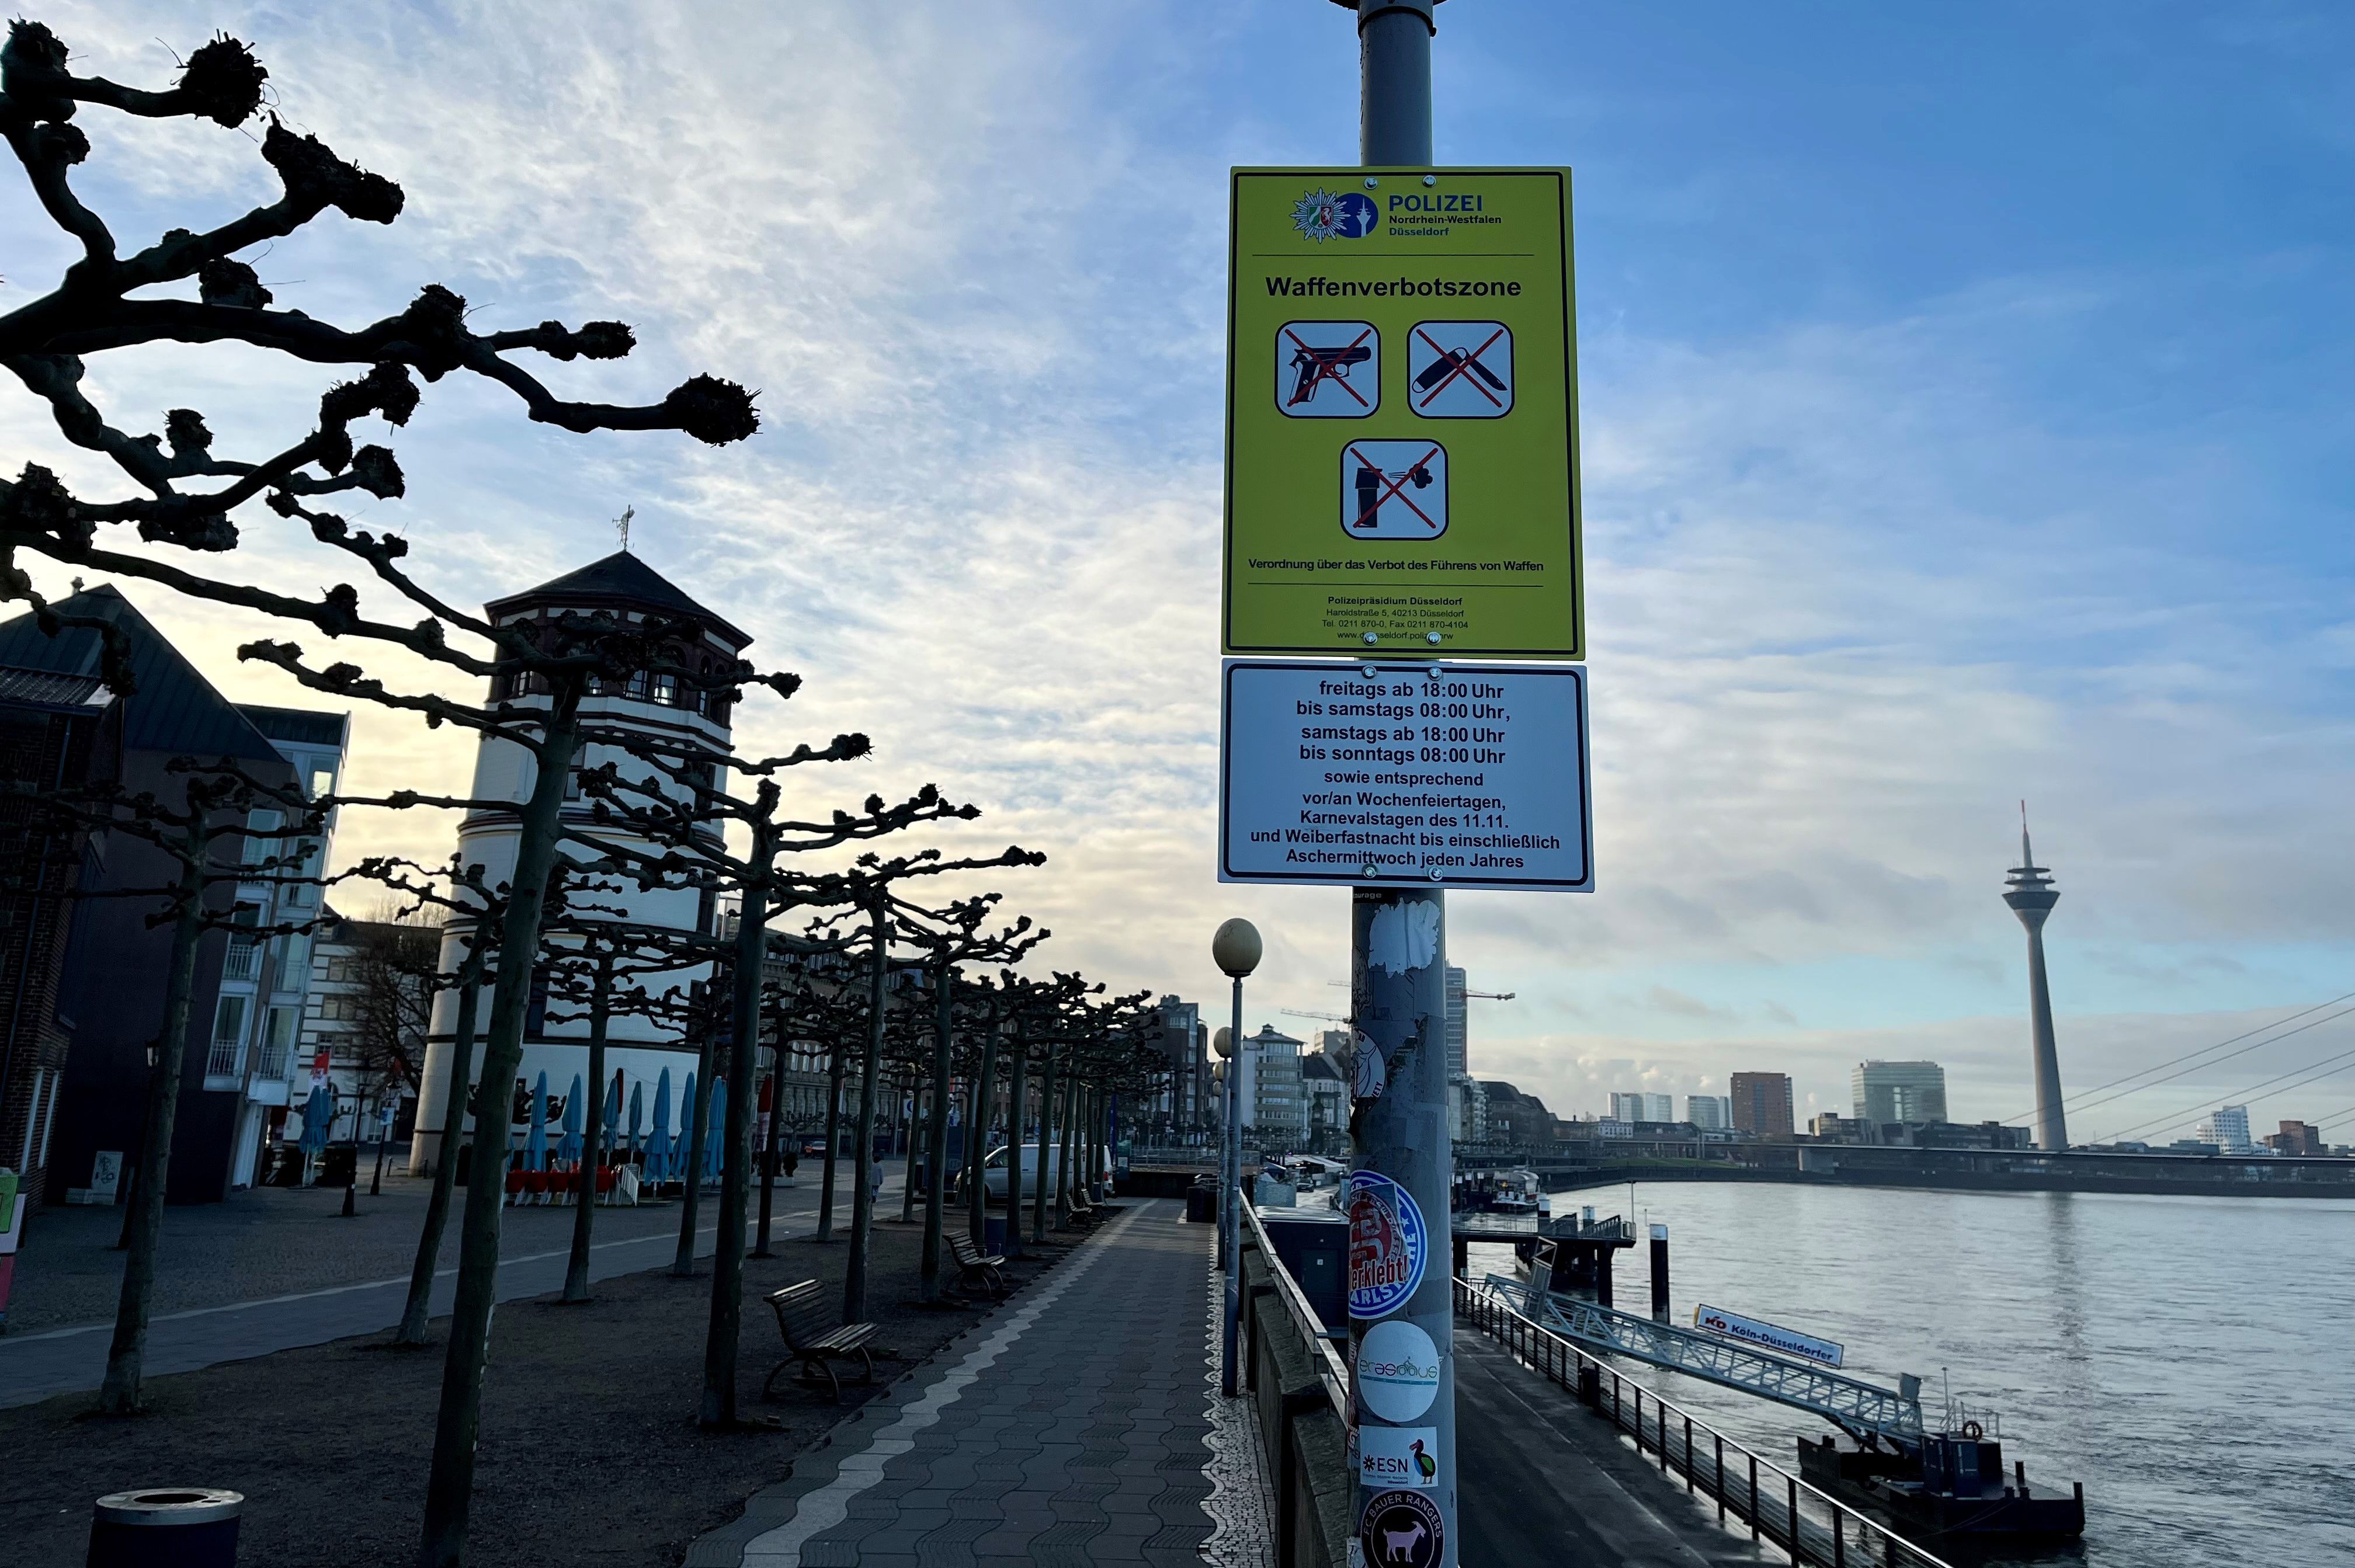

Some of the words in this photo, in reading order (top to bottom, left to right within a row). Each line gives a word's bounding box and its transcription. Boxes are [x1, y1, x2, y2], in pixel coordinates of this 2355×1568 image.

[1389, 194, 1482, 212] POLIZEI
[1389, 215, 1502, 224] Nordrhein-Westfalen
[1389, 227, 1450, 236] Düsseldorf
[1265, 277, 1522, 297] Waffenverbotszone
[1248, 558, 1314, 572] Verordnung
[1317, 559, 1343, 569] über
[1345, 559, 1366, 569] das
[1367, 559, 1405, 570] Verbot
[1407, 560, 1428, 570] des
[1430, 559, 1477, 571] Führens
[1479, 562, 1501, 571] von
[1503, 561, 1544, 571] Waffen
[1328, 596, 1407, 606] Polizeipräsidium
[1410, 597, 1463, 606] Düsseldorf
[1326, 609, 1380, 617] Haroldstraße
[1381, 609, 1390, 617] 5,
[1391, 609, 1418, 617] 40213
[1420, 609, 1464, 618] Düsseldorf
[1338, 620, 1357, 628] 0211
[1390, 620, 1405, 628] Fax
[1407, 620, 1426, 628] 0211
[1429, 621, 1468, 629] 870-4104
[1319, 680, 1387, 700] freitags
[1392, 682, 1413, 697] ab
[1420, 682, 1468, 698] 18:00
[1472, 683, 1504, 698] Uhr
[1297, 700, 1323, 715] bis
[1328, 702, 1414, 721] samstags
[1420, 703, 1468, 718] 08:00
[1472, 704, 1510, 722] Uhr,
[1301, 725, 1387, 744] samstags
[1393, 726, 1415, 741] ab
[1421, 726, 1468, 742] 18:00
[1472, 727, 1505, 743] Uhr
[1300, 744, 1326, 760] bis
[1332, 746, 1415, 766] sonntags
[1420, 747, 1469, 763] 08:00
[1473, 748, 1506, 764] Uhr
[1324, 770, 1370, 784] sowie
[1374, 771, 1484, 788] entsprechend
[1302, 791, 1352, 805] vor/an
[1356, 792, 1506, 812] Wochenfeiertagen,
[1301, 810, 1424, 830] Karnevalstagen
[1429, 813, 1457, 827] des
[1463, 813, 1509, 828] 11.11.
[1251, 829, 1280, 842] und
[1285, 829, 1416, 846] Weiberfastnacht
[1420, 832, 1444, 846] bis
[1449, 833, 1560, 849] einschließlich
[1286, 849, 1416, 865] Aschermittwoch
[1420, 851, 1464, 869] jeden
[1470, 853, 1524, 868] Jahres
[1706, 1316, 1727, 1330] KD
[1731, 1324, 1834, 1361] Köln-Düsseldorfer
[1377, 1457, 1408, 1473] ESN
[1368, 1494, 1402, 1518] BAUER
[1406, 1494, 1443, 1538] RANGERS
